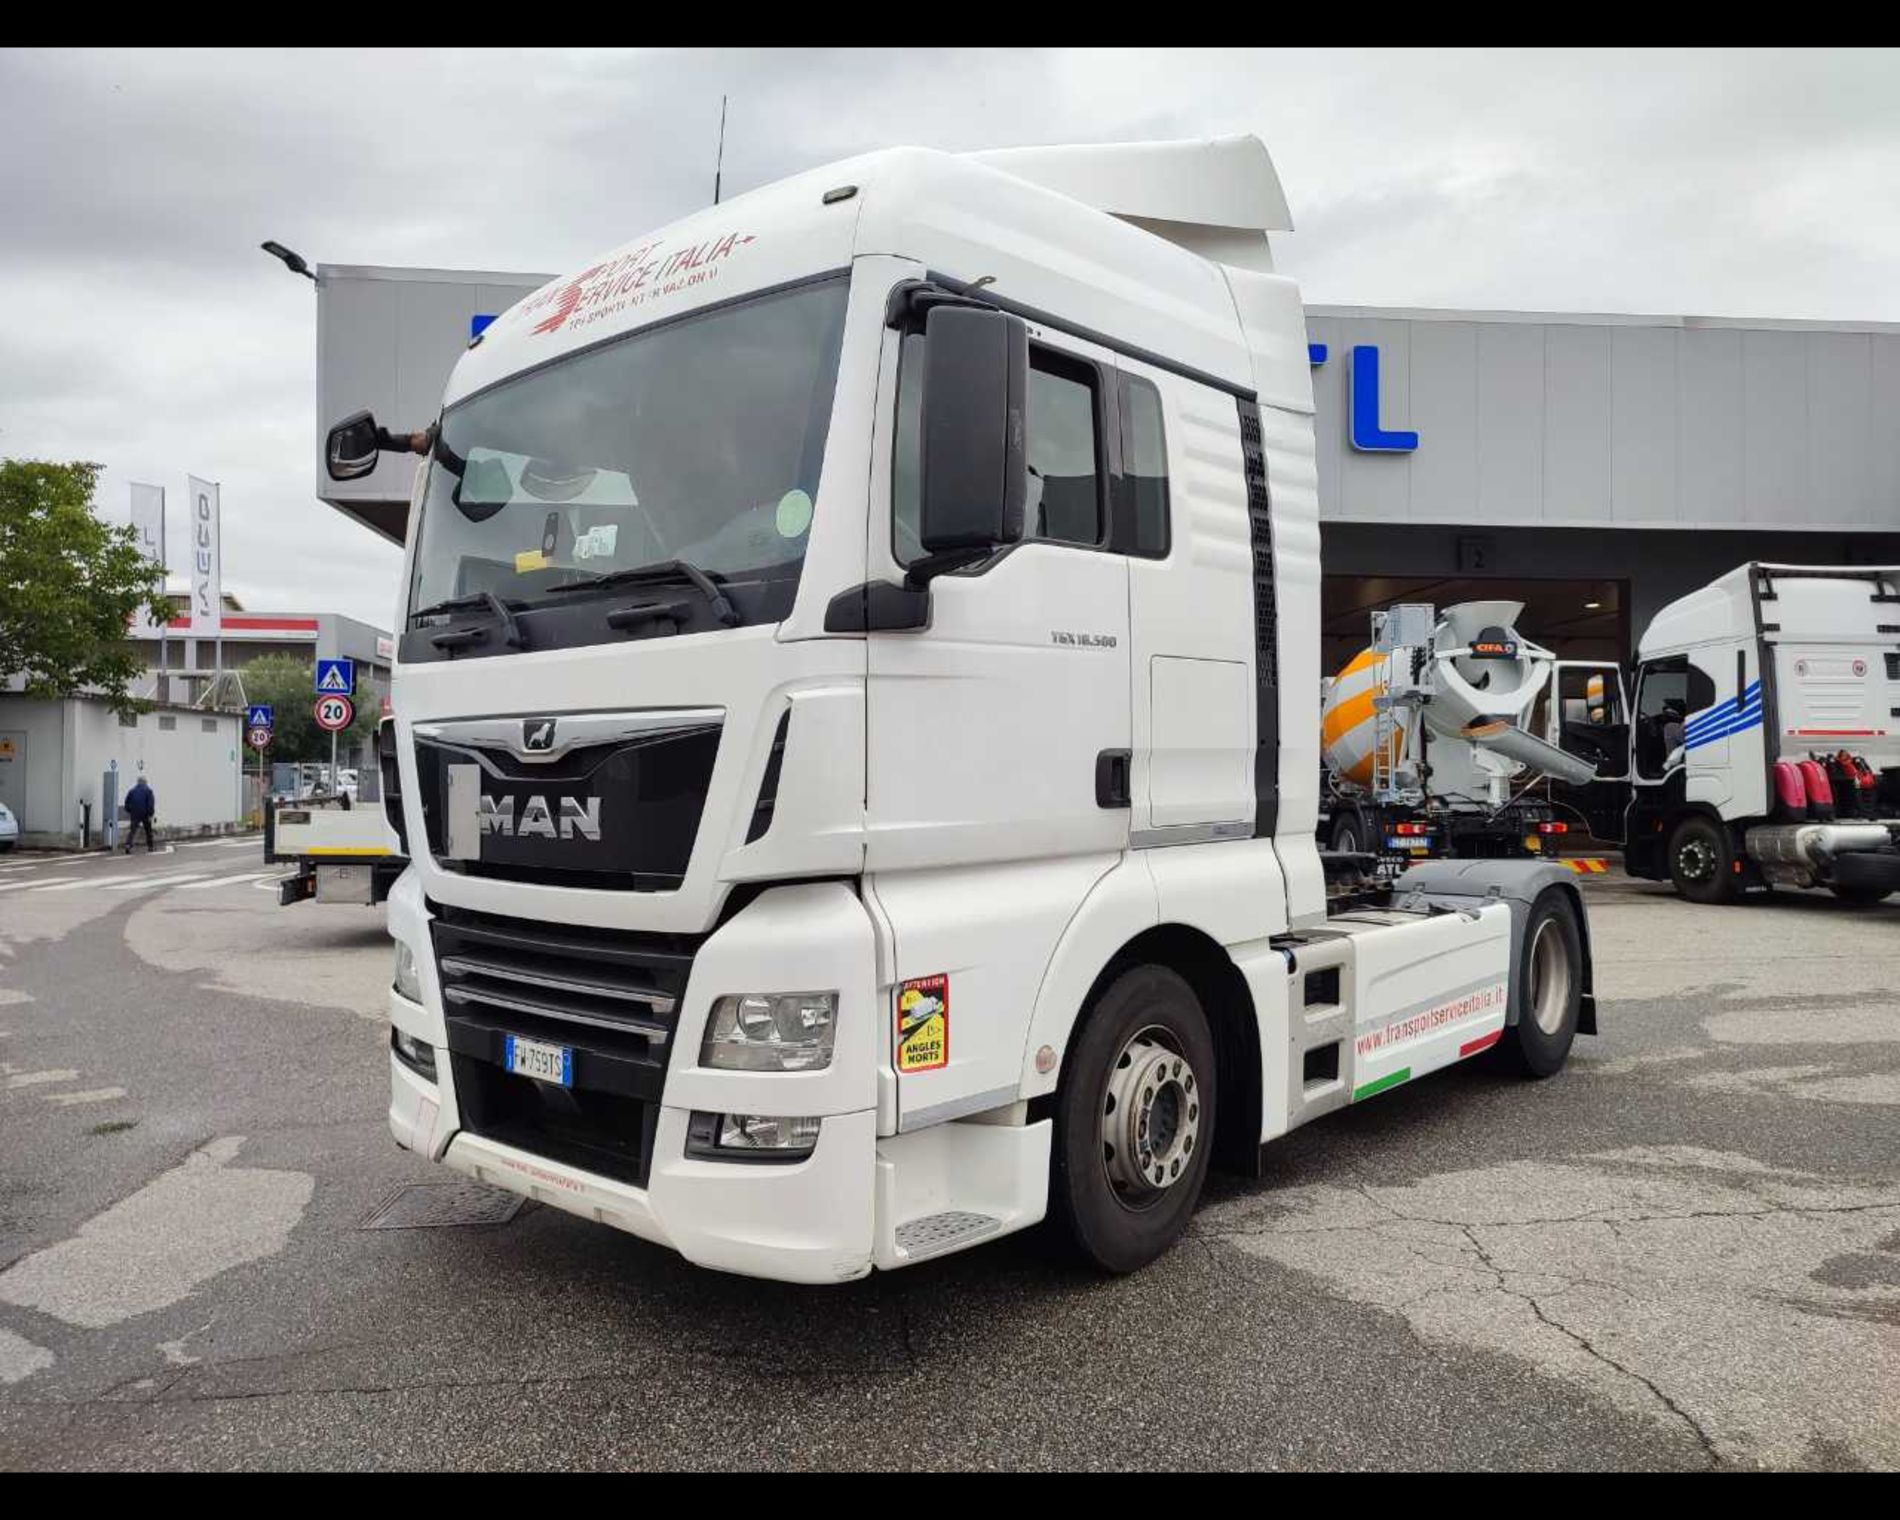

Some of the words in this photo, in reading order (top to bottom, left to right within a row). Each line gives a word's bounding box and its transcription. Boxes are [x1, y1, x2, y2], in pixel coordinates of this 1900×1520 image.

[654, 232, 738, 282] ITALIA
[324, 705, 343, 719] 20
[253, 732, 265, 742] 20
[479, 795, 601, 841] MAN
[906, 1040, 941, 1054] ANGLES
[907, 1050, 940, 1065] MORTS
